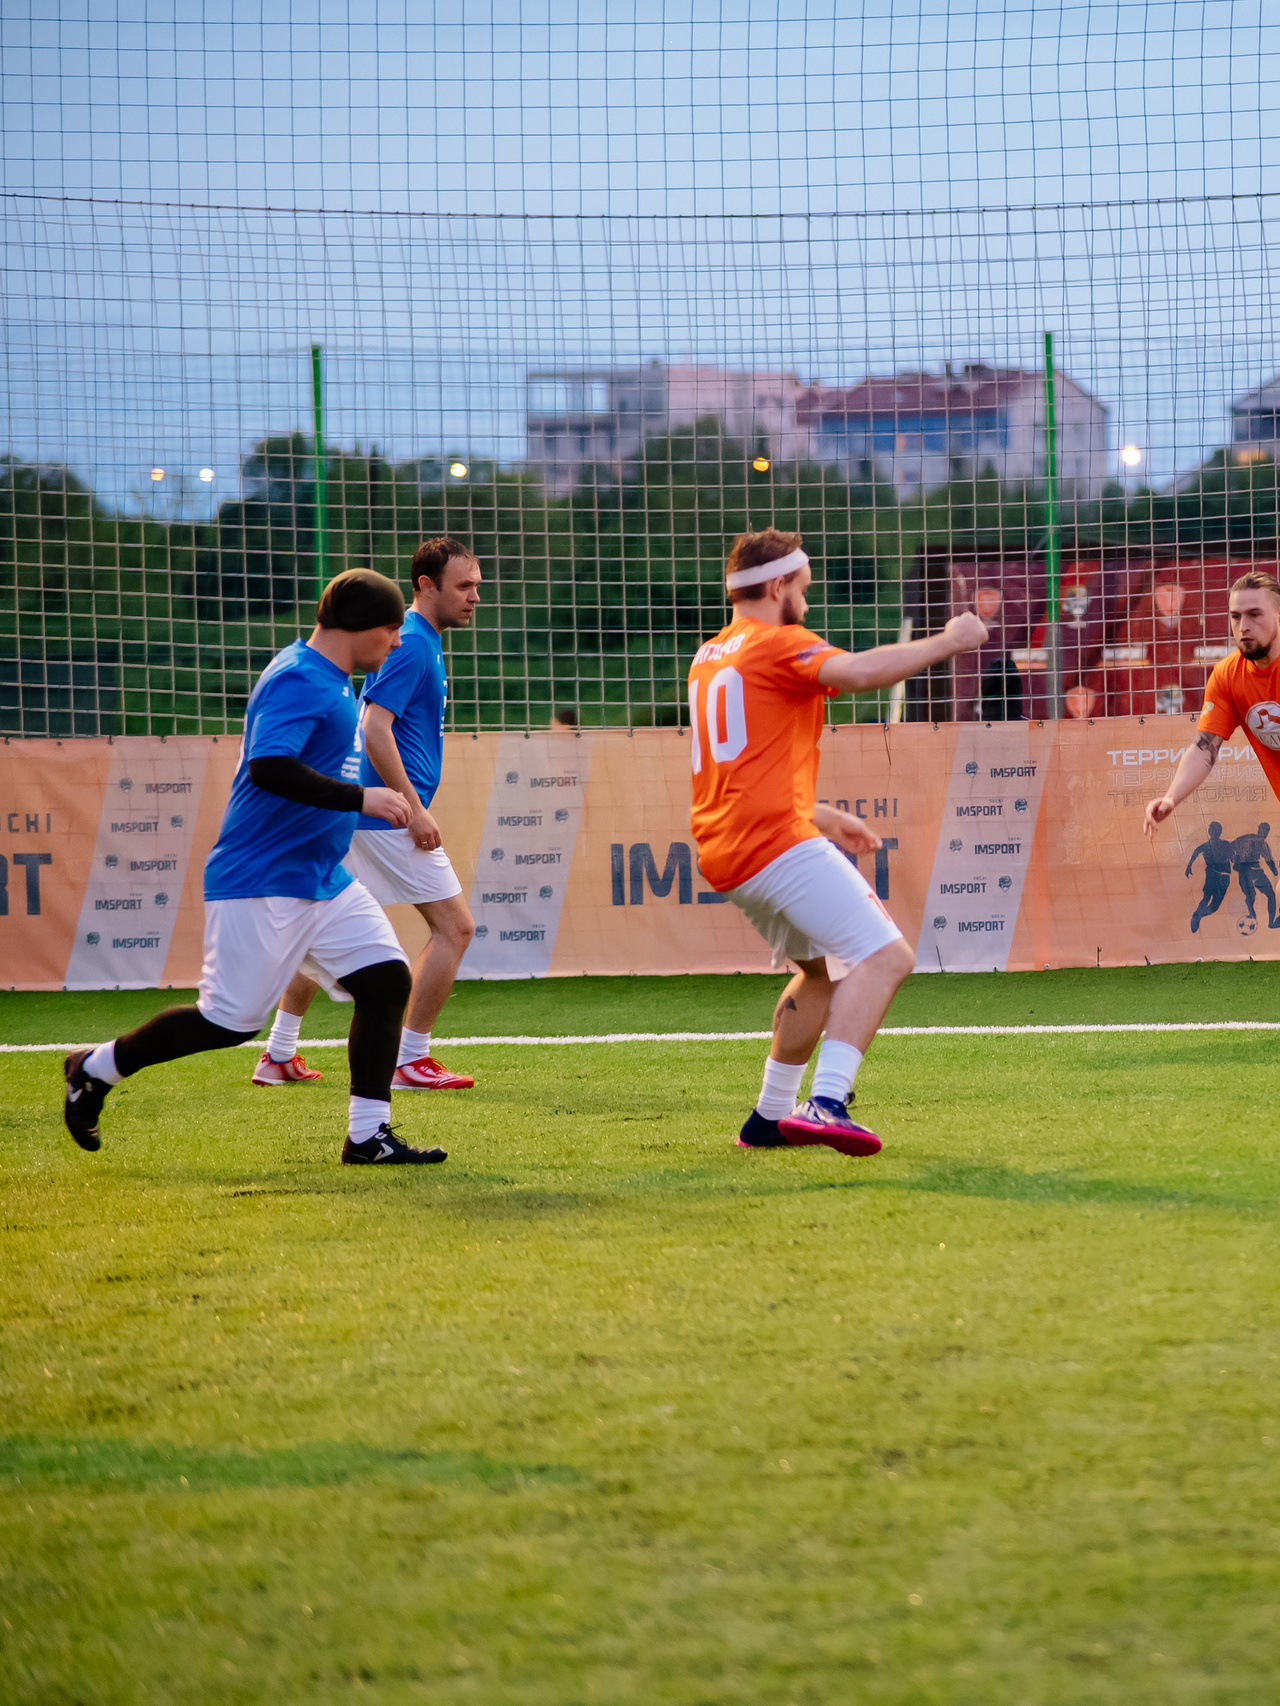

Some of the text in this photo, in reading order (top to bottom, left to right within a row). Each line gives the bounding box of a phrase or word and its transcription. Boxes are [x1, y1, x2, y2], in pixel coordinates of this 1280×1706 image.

[689, 665, 748, 775] 10
[990, 766, 1037, 778] IMSPORT
[530, 776, 578, 788] IMSPORT
[145, 783, 192, 794] IMSPORT
[956, 805, 1003, 817] IMSPORT
[0, 813, 52, 834] CHI
[111, 821, 159, 833] IMSPORT
[497, 815, 543, 827] IMSPORT
[974, 843, 1021, 855] IMSPORT
[515, 853, 562, 865] IMSPORT
[130, 860, 178, 871] IMSPORT
[940, 882, 987, 894] IMSPORT
[482, 892, 528, 904] IMSPORT
[95, 899, 143, 910] IMSPORT
[958, 920, 1005, 932] IMSPORT
[500, 930, 546, 942] IMSPORT
[112, 937, 161, 949] IMSPORT
